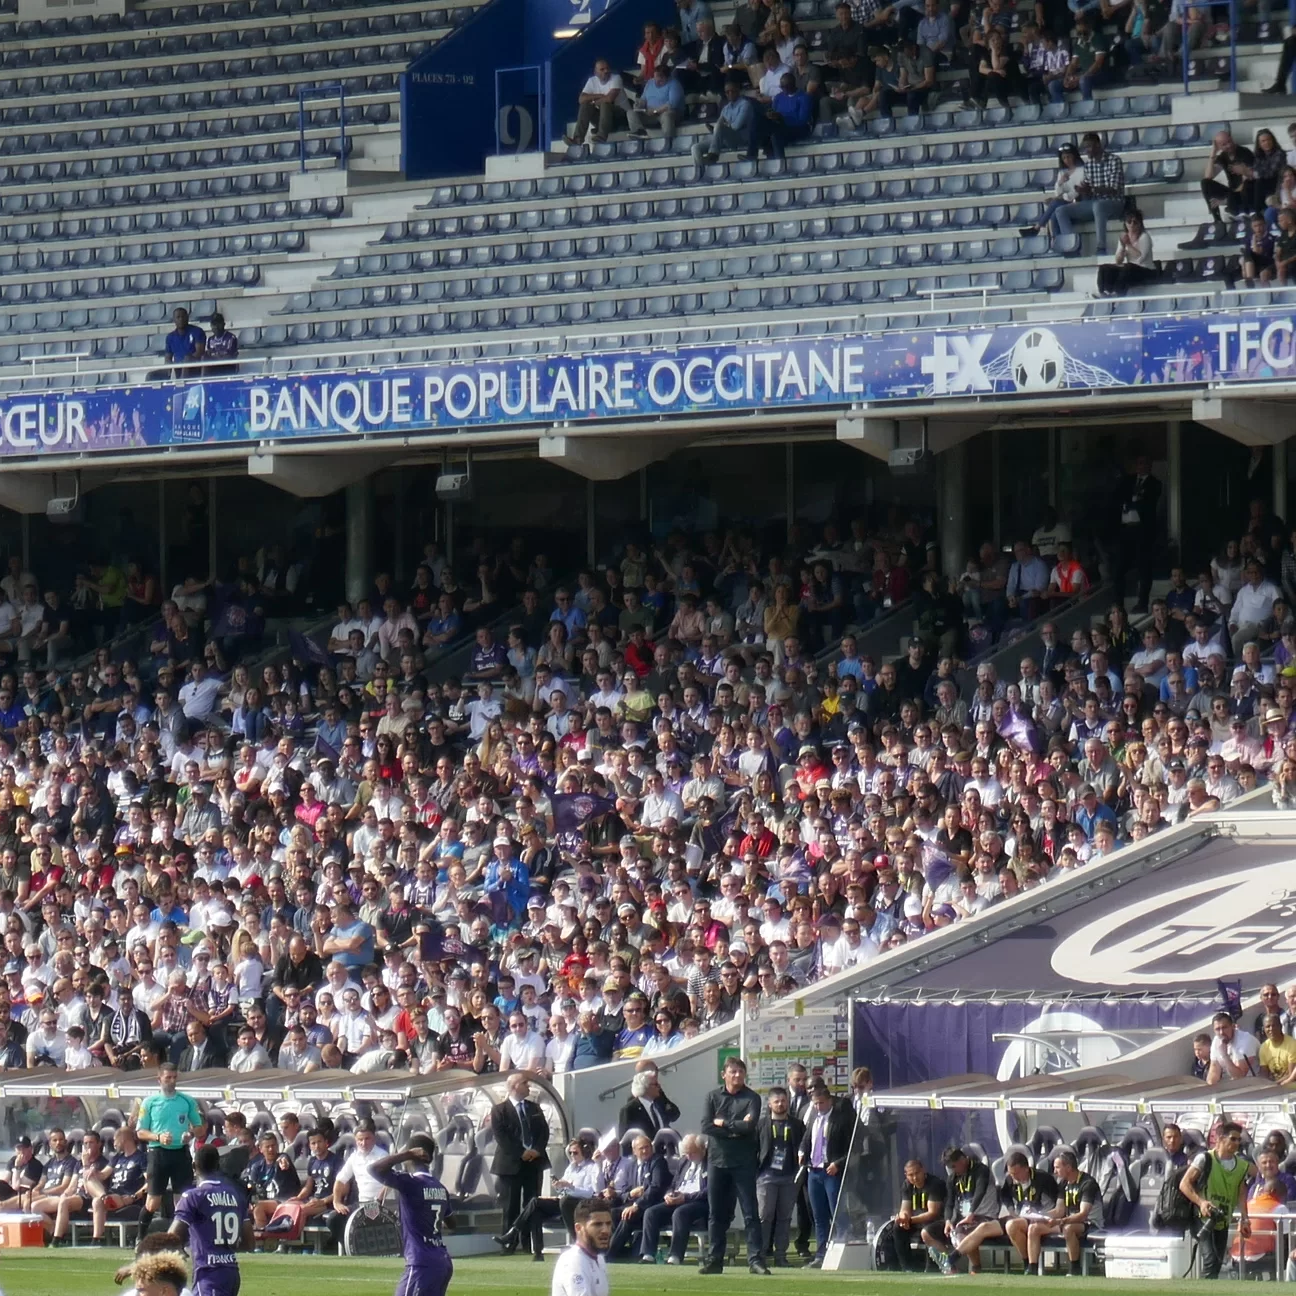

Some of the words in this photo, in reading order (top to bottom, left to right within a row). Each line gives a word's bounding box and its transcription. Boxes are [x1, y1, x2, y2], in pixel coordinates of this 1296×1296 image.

[1208, 320, 1295, 371] TFC
[250, 377, 411, 433] BANQUE
[424, 360, 634, 421] POPULAIRE
[646, 345, 864, 405] OCCITANE
[211, 1211, 239, 1245] 19
